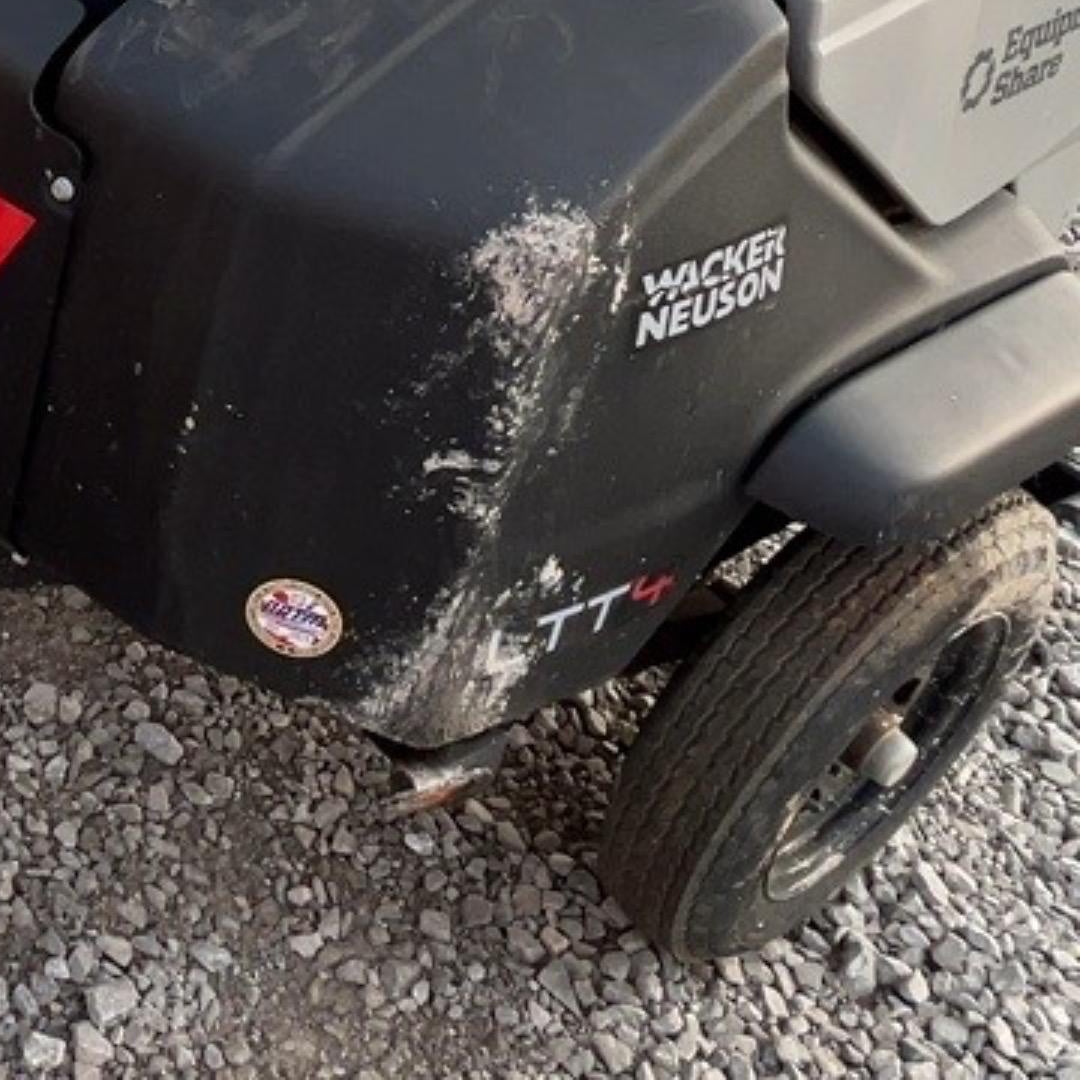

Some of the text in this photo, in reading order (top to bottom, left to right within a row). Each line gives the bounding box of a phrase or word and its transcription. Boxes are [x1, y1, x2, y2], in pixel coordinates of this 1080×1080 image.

[990, 52, 1063, 106] Share
[634, 257, 785, 348] NEUSON
[641, 224, 787, 307] WACKER
